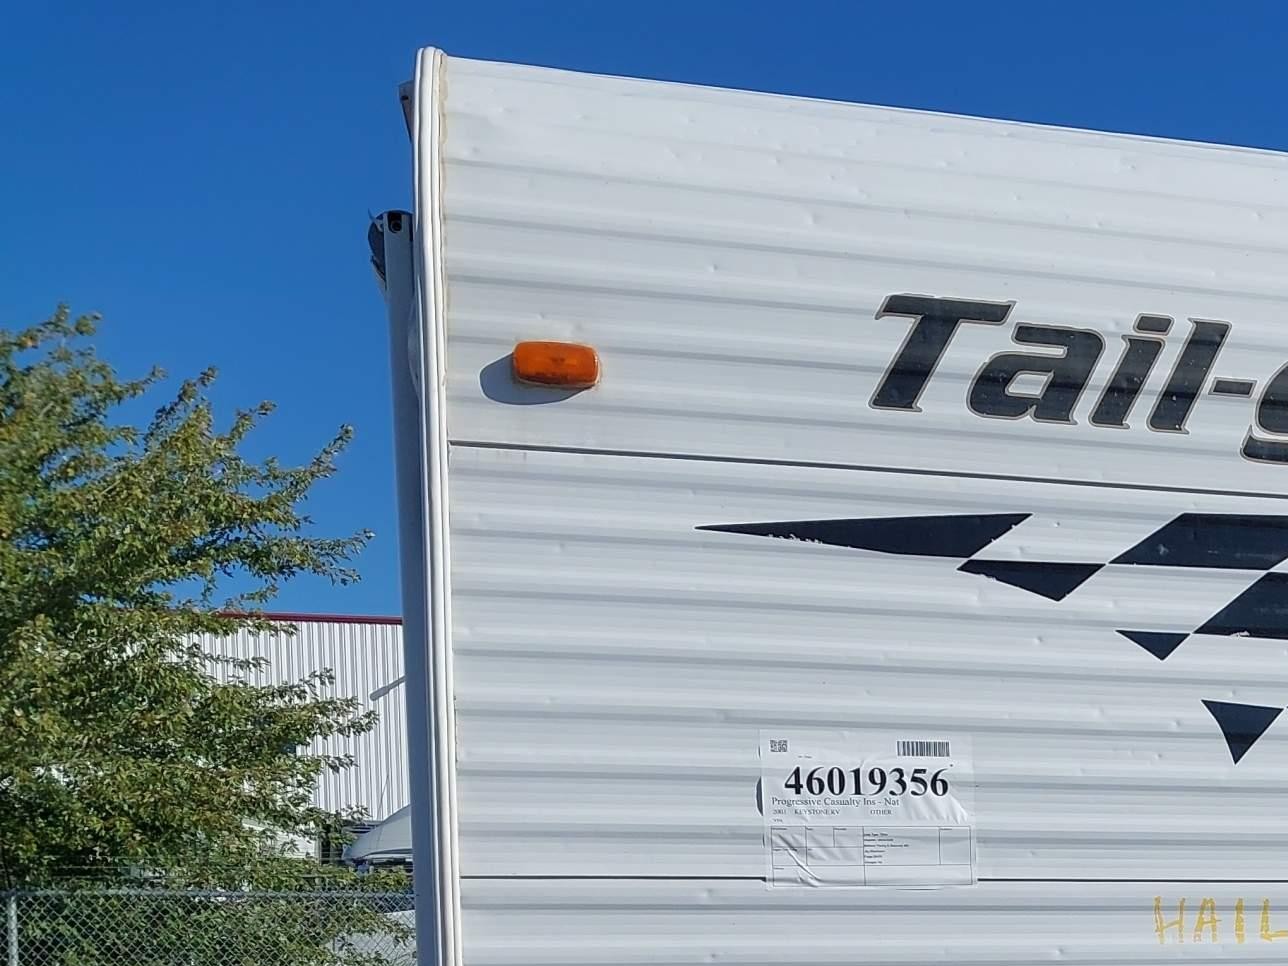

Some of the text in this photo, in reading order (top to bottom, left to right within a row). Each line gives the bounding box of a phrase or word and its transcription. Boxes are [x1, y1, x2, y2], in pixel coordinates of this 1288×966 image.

[784, 766, 949, 796] 46019356
[771, 797, 821, 807] Progressive
[823, 797, 860, 807] Casualty
[863, 797, 876, 806] Ins
[884, 797, 900, 806] Nat
